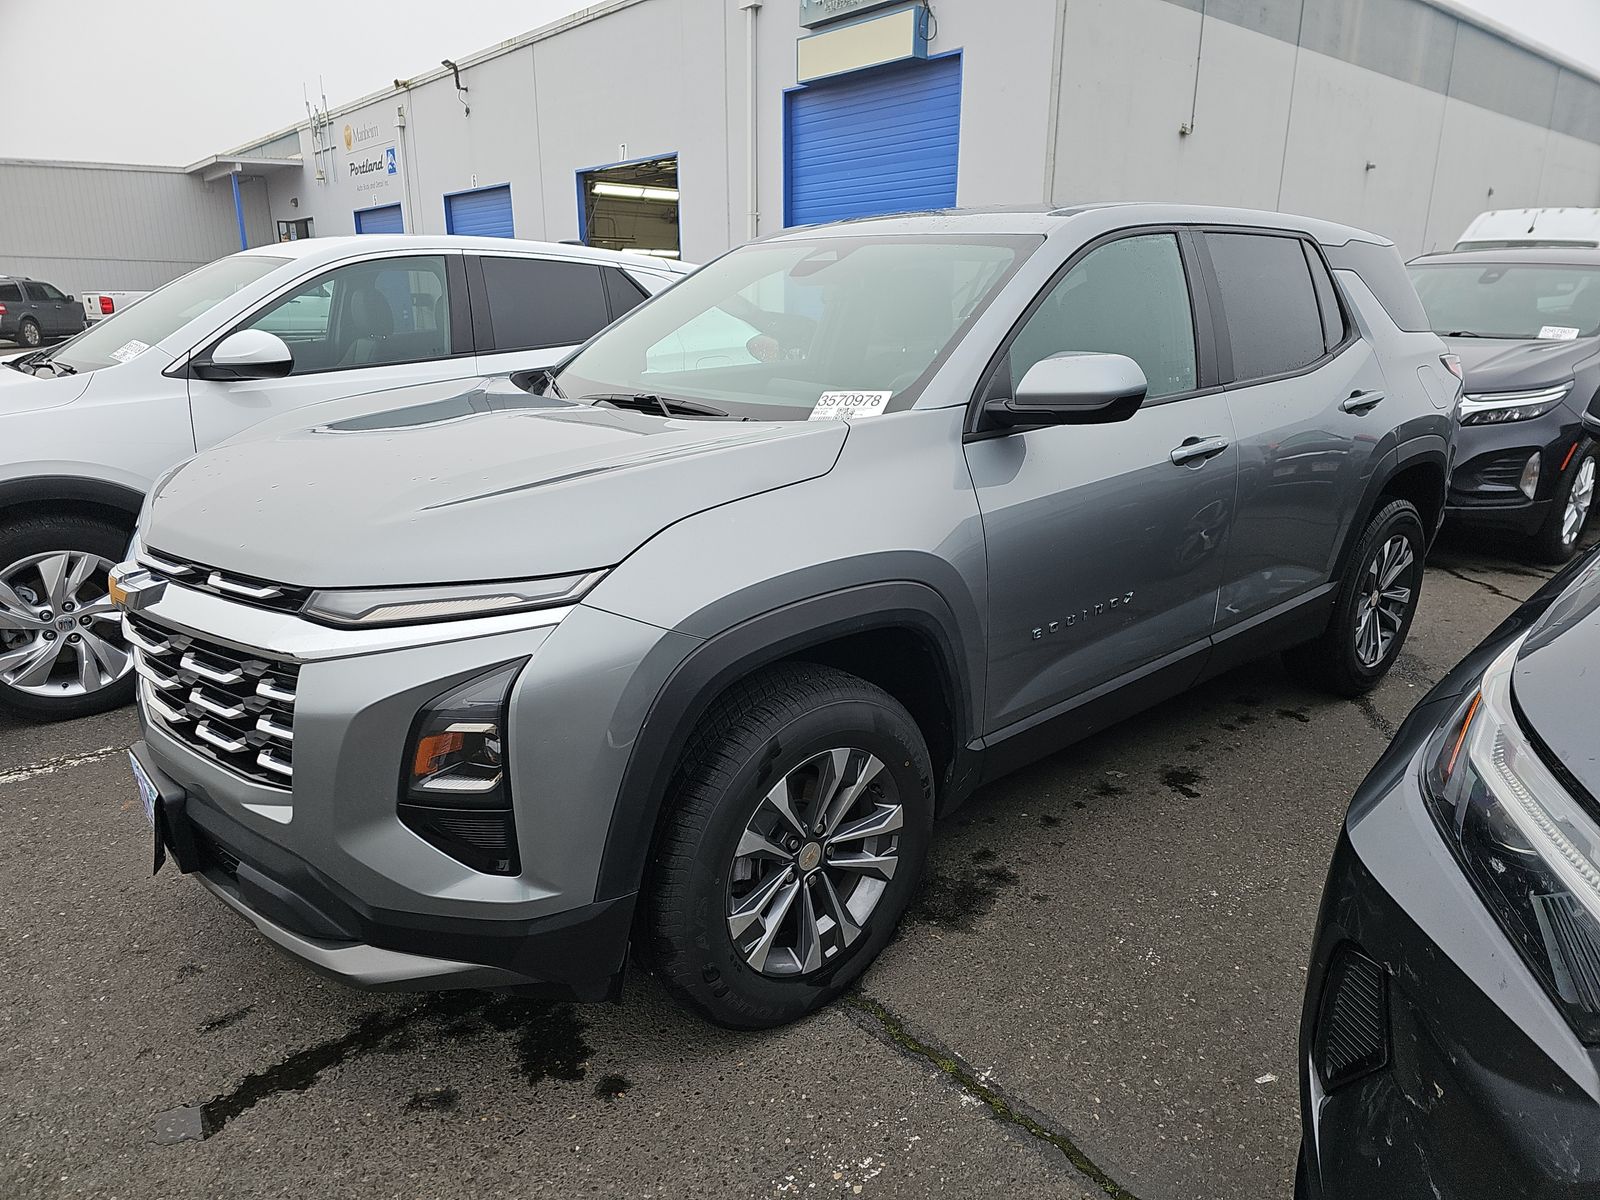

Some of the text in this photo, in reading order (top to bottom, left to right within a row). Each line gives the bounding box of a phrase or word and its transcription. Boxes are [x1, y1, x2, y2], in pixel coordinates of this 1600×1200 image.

[352, 122, 379, 143] Manheim
[620, 144, 626, 160] 7
[349, 154, 384, 177] Portland
[817, 394, 883, 407] 3570978
[1031, 591, 1135, 640] EQUINOX
